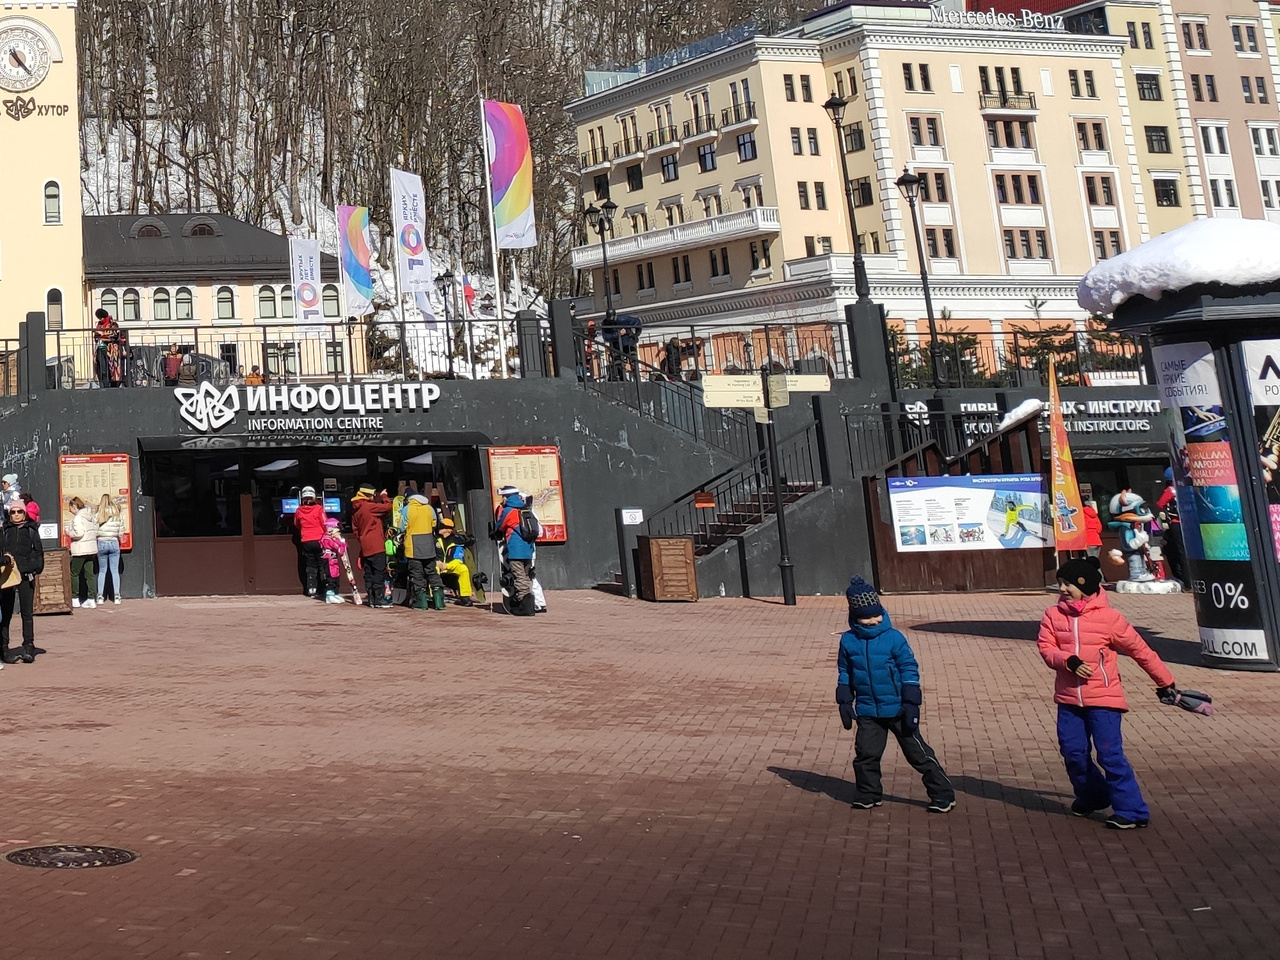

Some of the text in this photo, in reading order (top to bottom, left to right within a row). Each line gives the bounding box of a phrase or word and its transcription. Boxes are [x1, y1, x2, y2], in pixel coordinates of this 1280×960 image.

[928, 4, 1065, 30] Mercedes-Benz
[37, 104, 69, 117] ХУТОР
[401, 194, 409, 221] ЯРКИХ
[1161, 359, 1187, 372] САМЫЕ
[1165, 384, 1209, 398] СОБЫТИЯ!
[1265, 384, 1280, 396] РО
[246, 383, 441, 415] ИНФОЦЕНТР
[1088, 399, 1162, 414] ИНСТРУКТ
[248, 417, 384, 431] INFORMATION CENTRE
[1074, 420, 1151, 432] INSTRUCTORS
[1211, 582, 1249, 609] 0%
